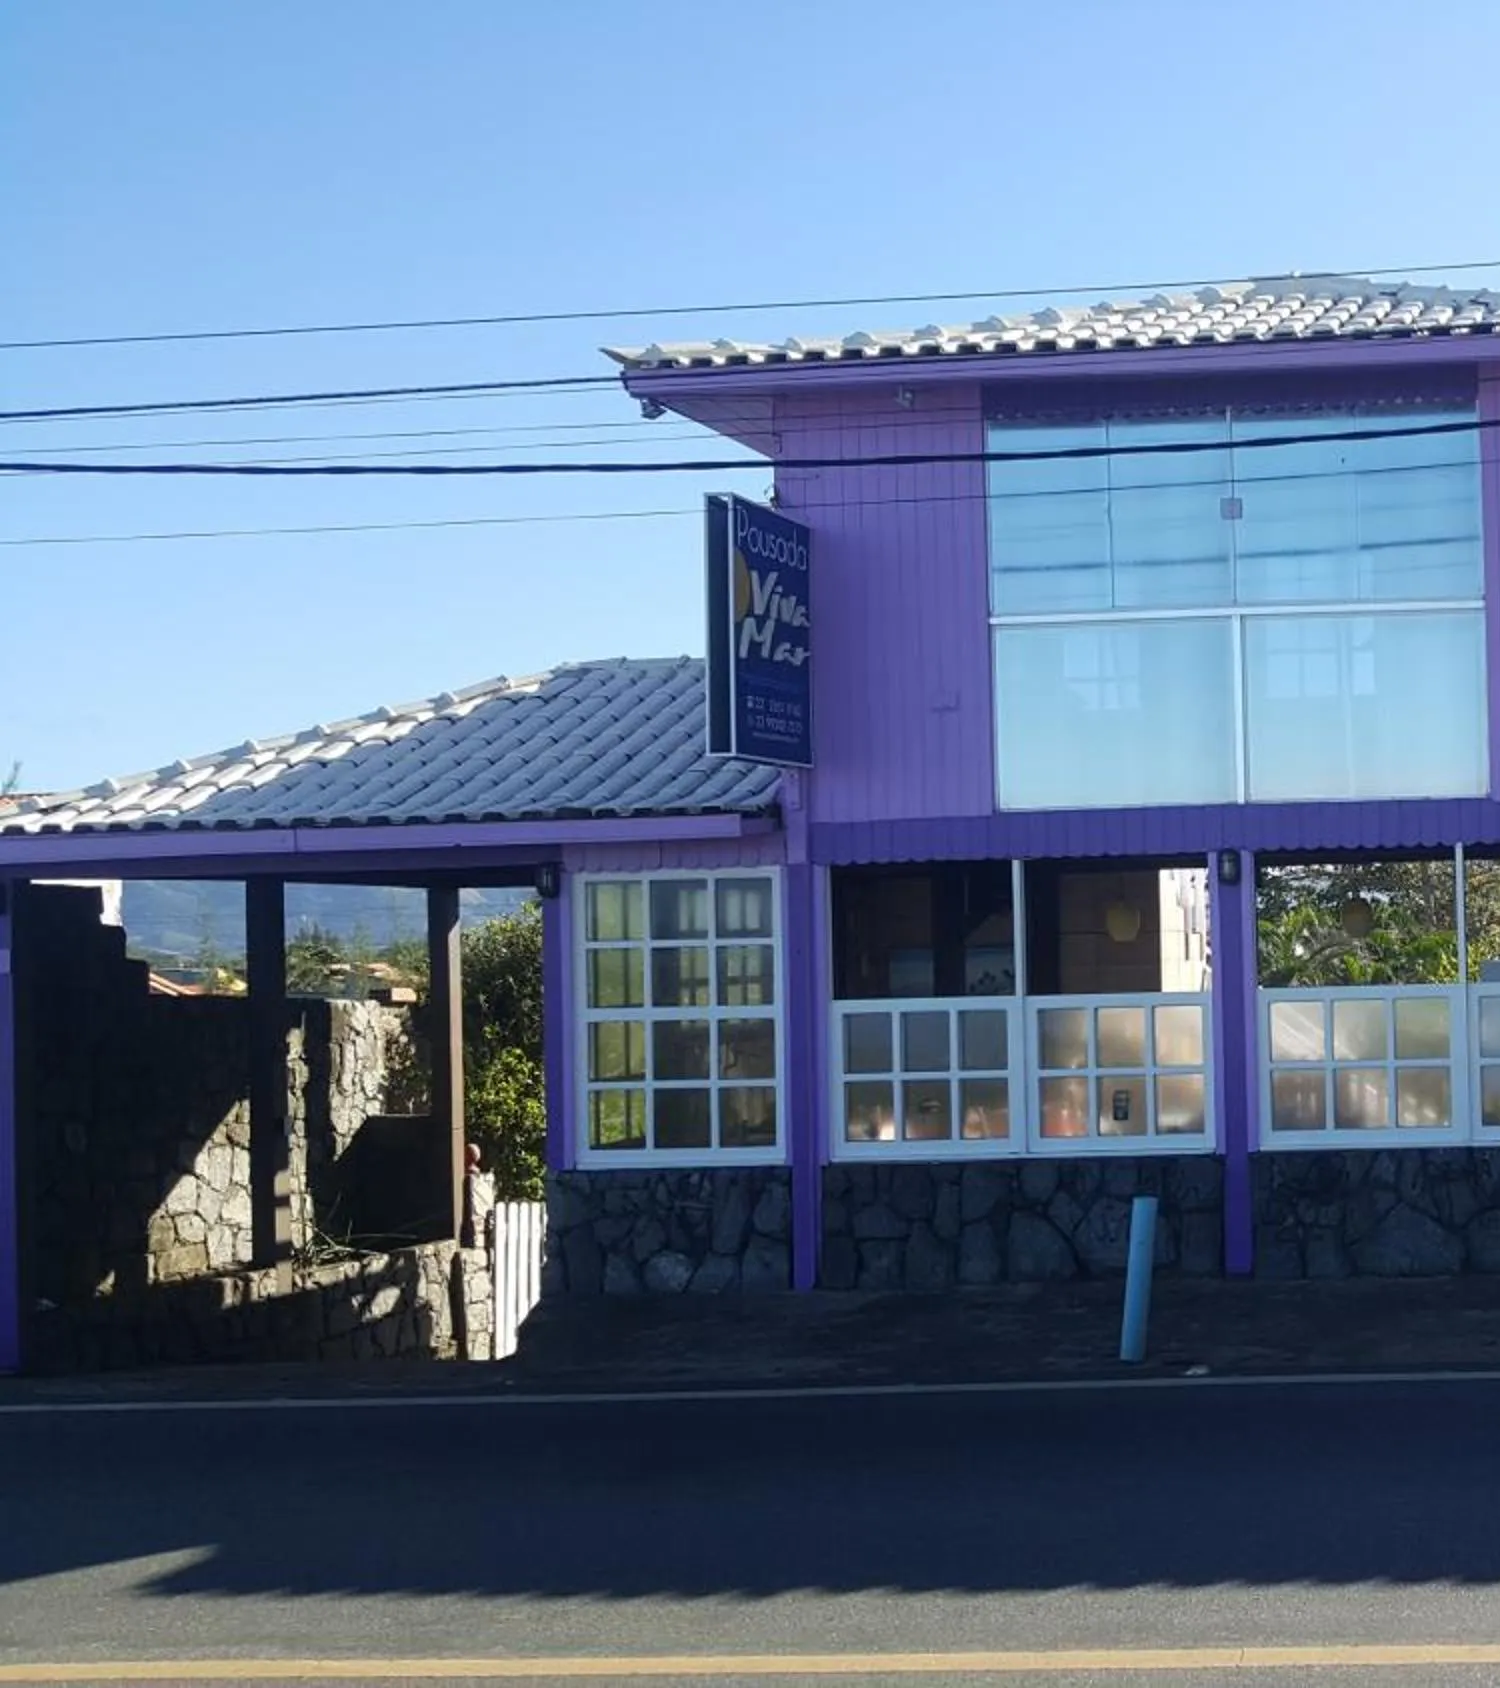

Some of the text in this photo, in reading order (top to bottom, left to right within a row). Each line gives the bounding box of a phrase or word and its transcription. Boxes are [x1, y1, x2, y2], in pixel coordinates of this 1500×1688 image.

[736, 505, 807, 571] Pousada
[750, 569, 810, 627] Viva
[738, 617, 811, 666] Mar
